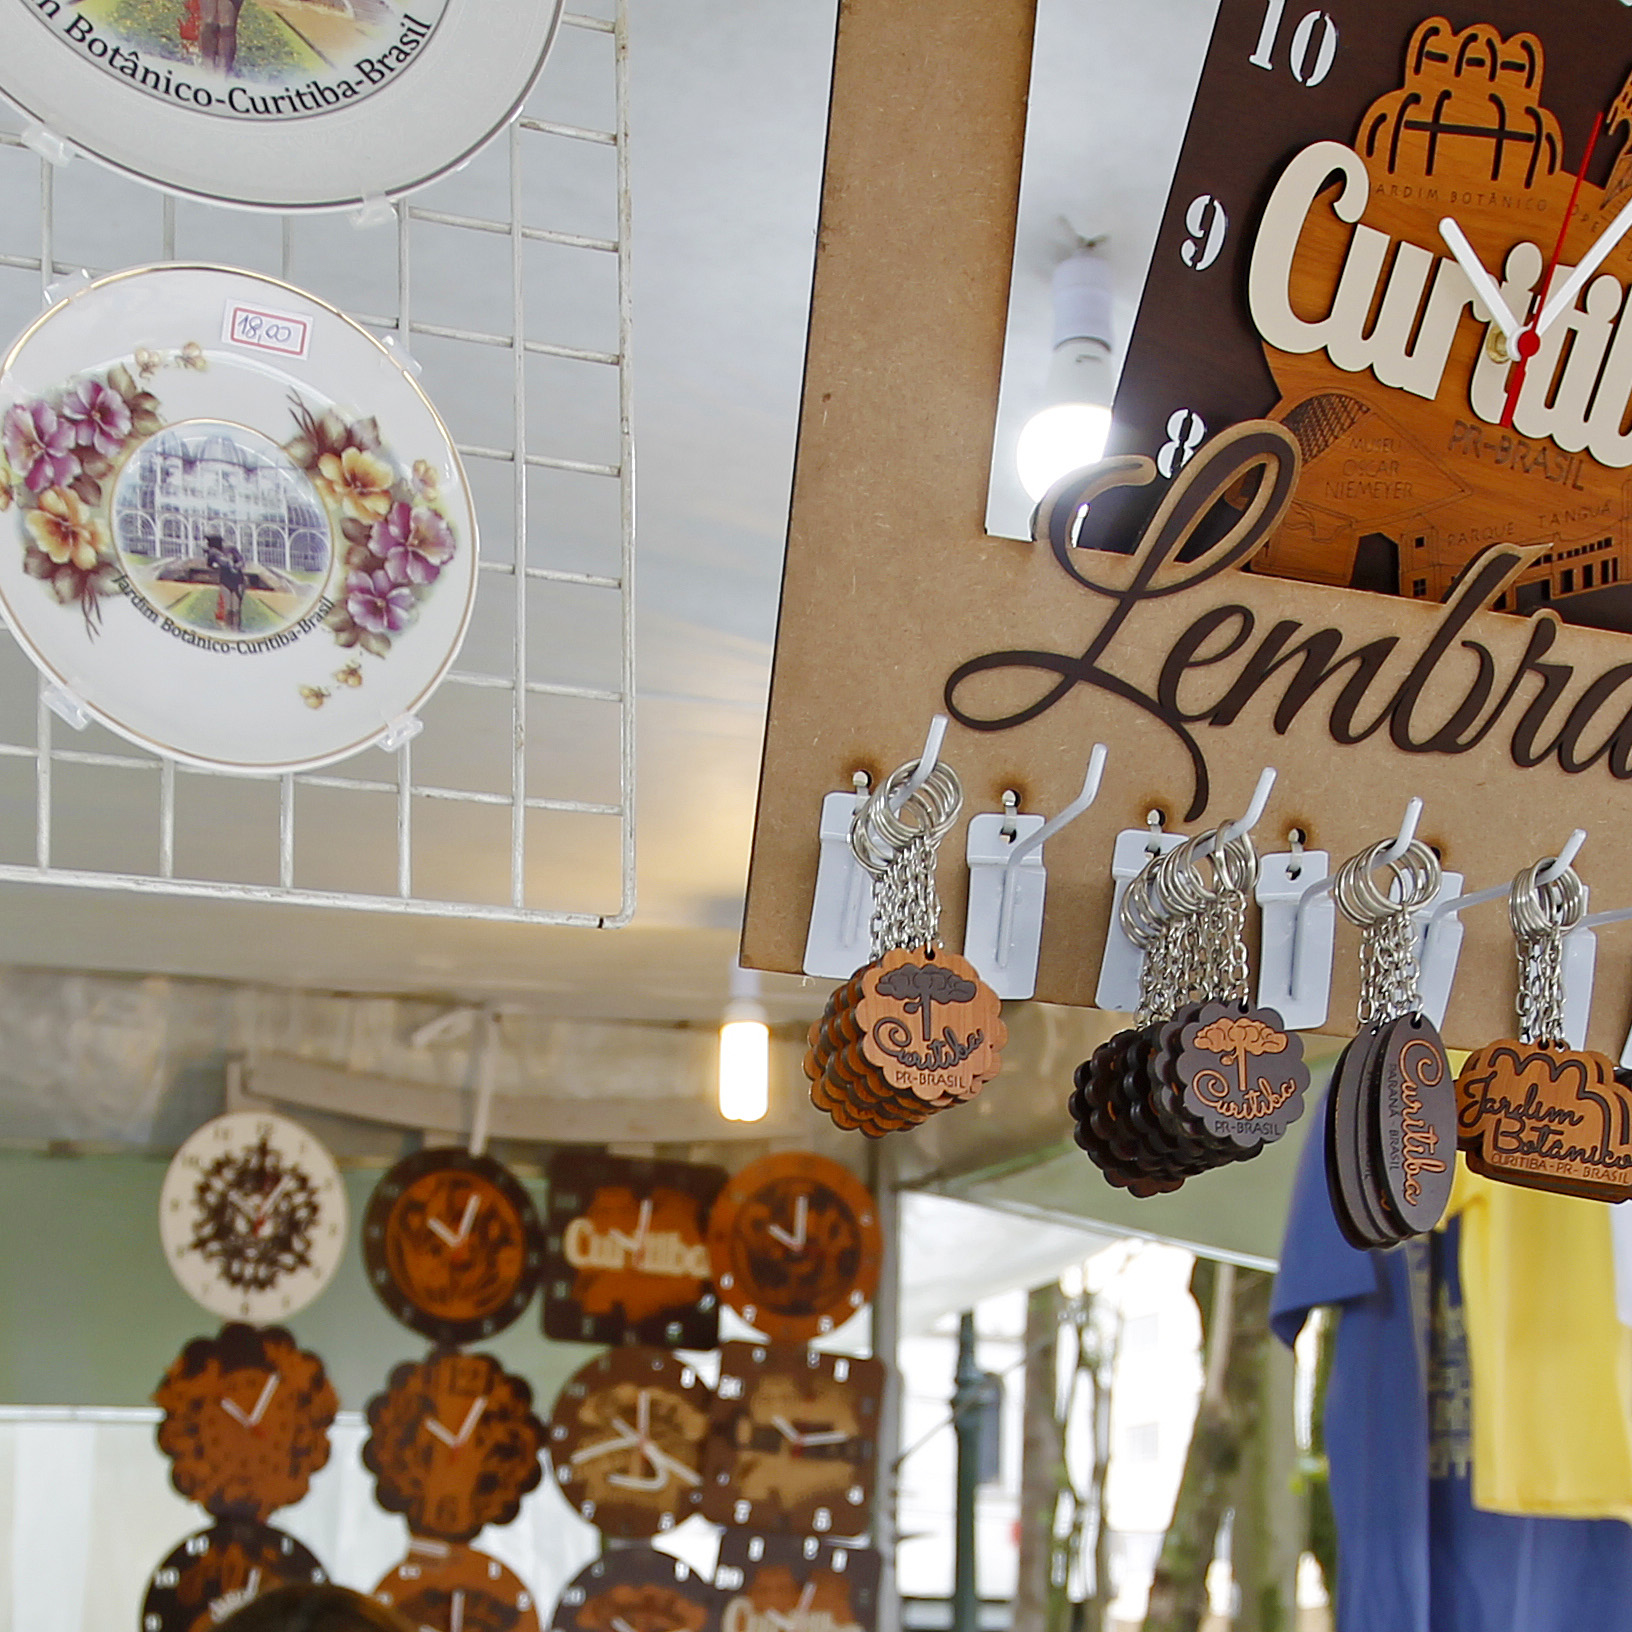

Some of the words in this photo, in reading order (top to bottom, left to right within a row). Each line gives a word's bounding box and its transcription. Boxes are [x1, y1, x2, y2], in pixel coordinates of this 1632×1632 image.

[64, 13, 433, 117] Botânico-Curitiba-Brasil
[1370, 182, 1439, 200] ARDIM
[1180, 194, 1229, 272] 9
[237, 315, 292, 344] 18,00
[1342, 459, 1401, 479] OSCAR
[1447, 419, 1586, 491] PR-BRASIL
[1324, 480, 1415, 500] NIEMEYER
[1447, 522, 1516, 547] PARQUE
[1537, 497, 1613, 529] TANGUÁ
[111, 573, 160, 624] Jardim
[160, 594, 336, 657] Botânico-Curitiba-Brasil
[873, 1016, 985, 1073] Curitiba
[894, 1069, 968, 1091] PR-BRASIL
[1191, 1067, 1298, 1121] Curitiba
[1458, 1074, 1585, 1137] Jardim
[1214, 1119, 1282, 1136] PR-BRASIL
[1399, 1038, 1447, 1208] Curitiba
[1490, 1154, 1547, 1172] CURITIBA
[1582, 1168, 1631, 1185] BRASIL
